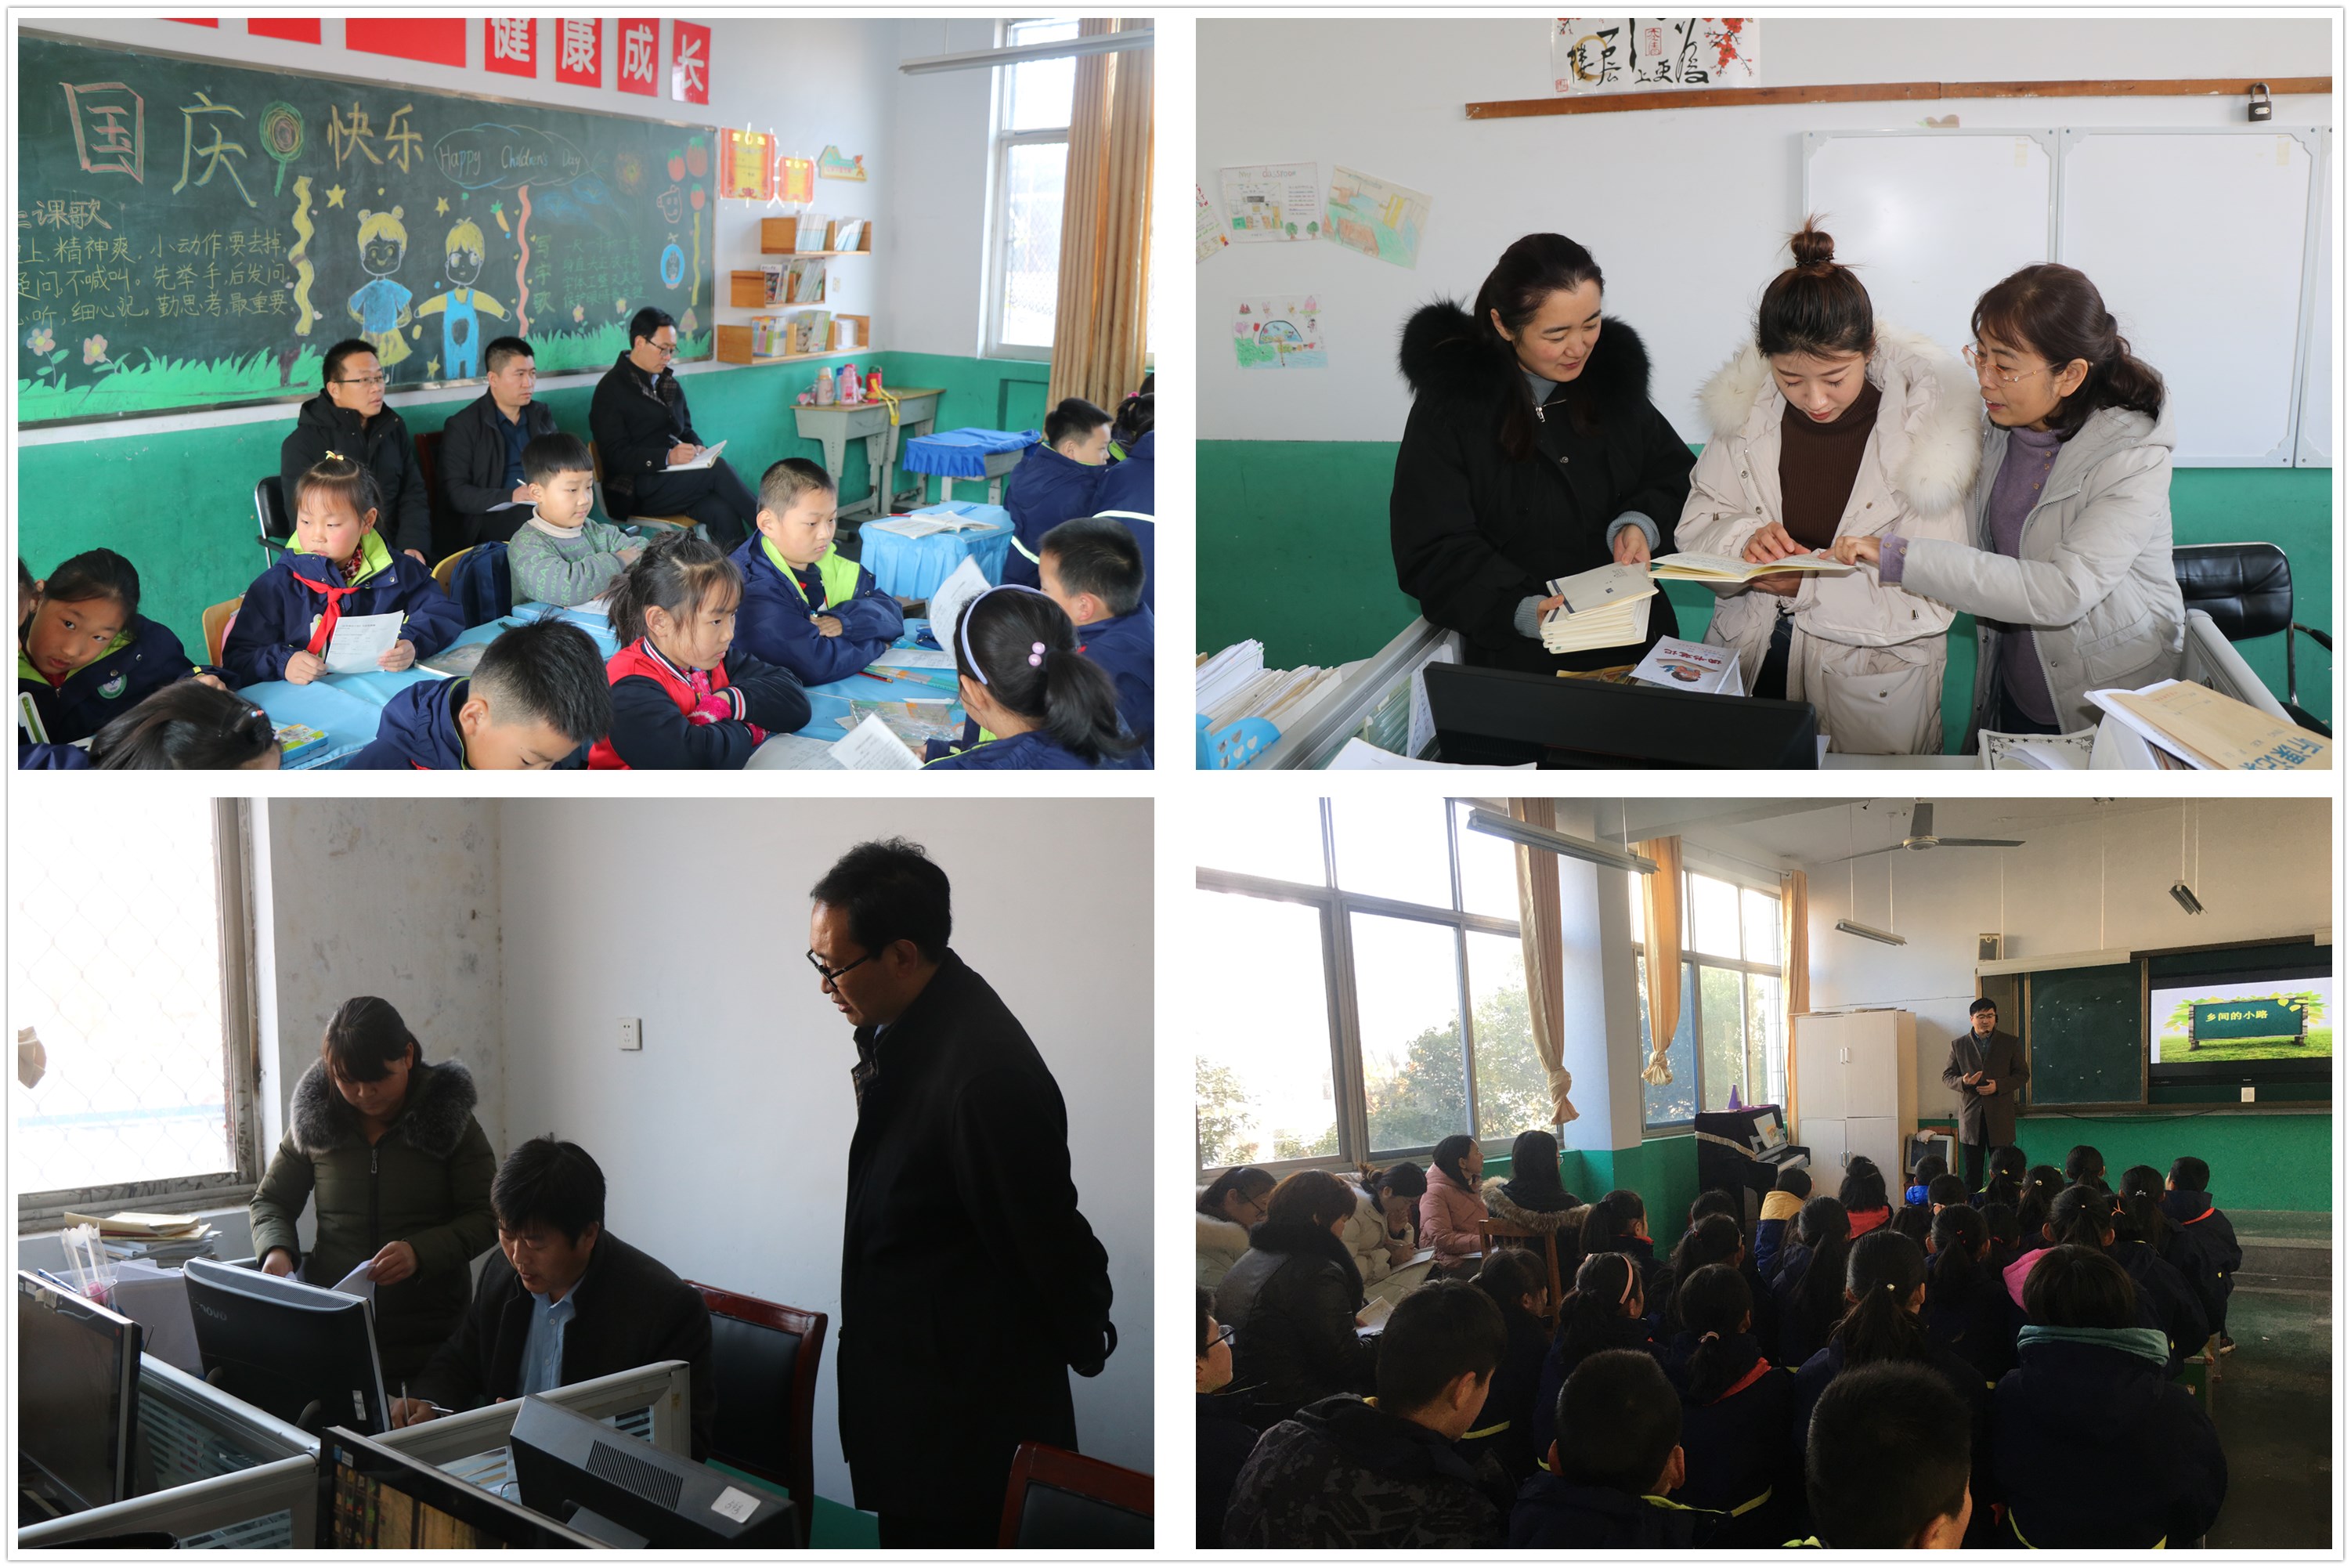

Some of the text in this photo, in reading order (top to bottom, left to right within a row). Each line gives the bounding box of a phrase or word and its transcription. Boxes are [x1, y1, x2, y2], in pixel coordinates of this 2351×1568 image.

[491, 18, 705, 92] 健康成长
[59, 81, 424, 208] 国庆 快乐
[439, 144, 481, 179] Happy
[562, 148, 581, 176] Day
[533, 235, 555, 314] 写字歌
[2205, 1010, 2268, 1022] 乡间的小路
